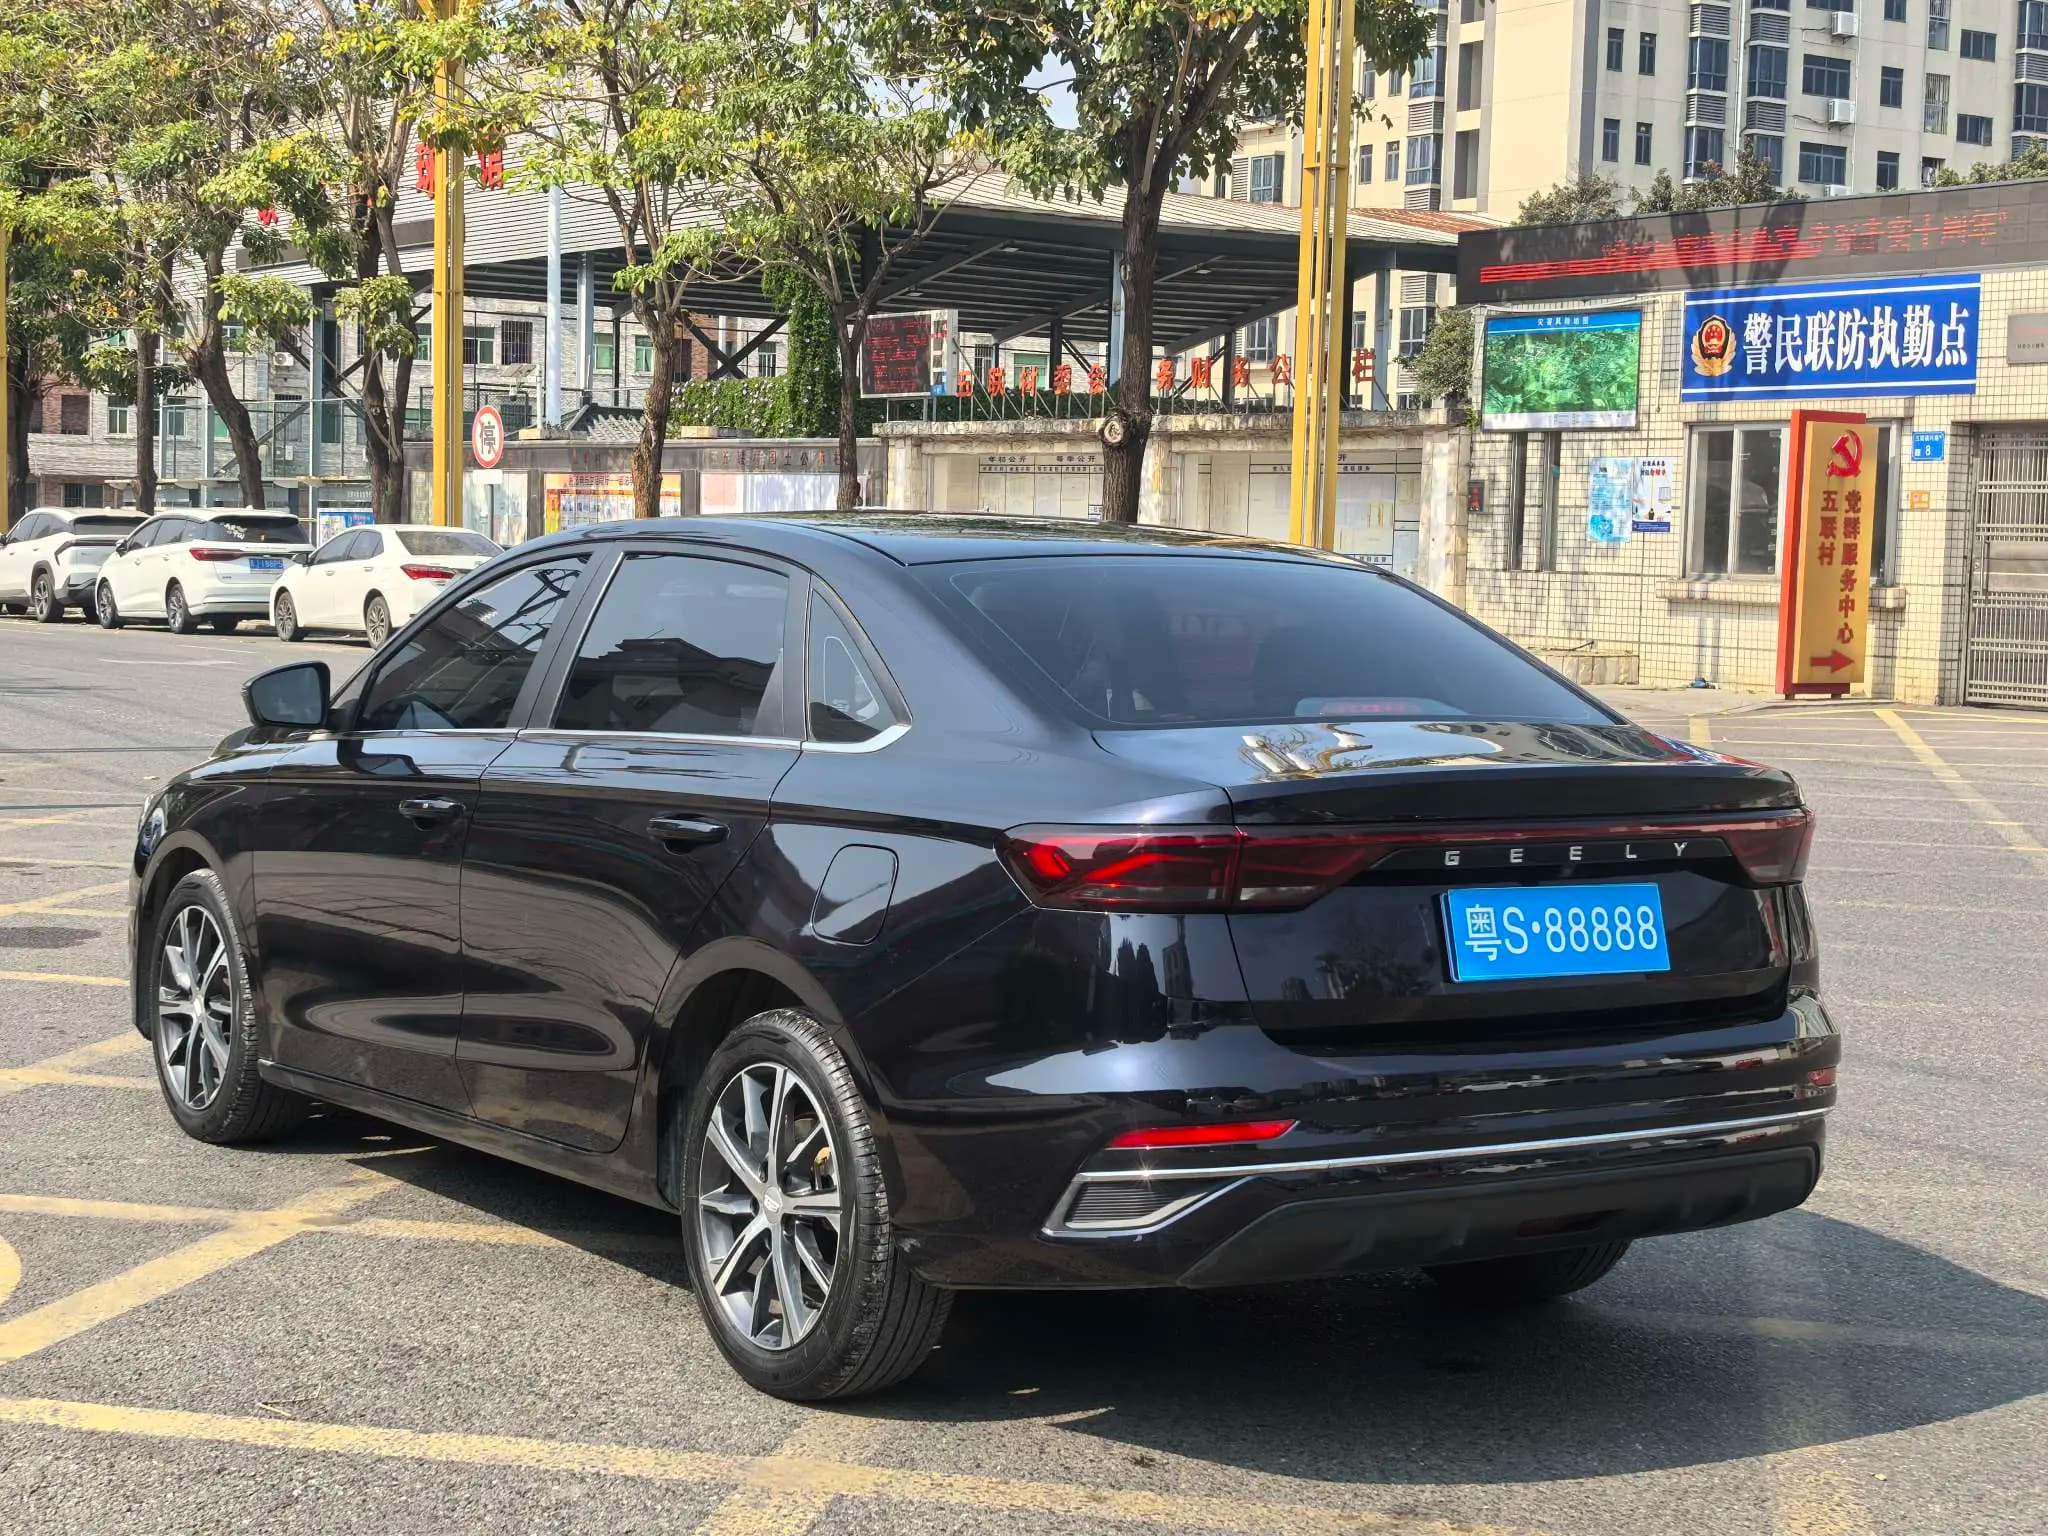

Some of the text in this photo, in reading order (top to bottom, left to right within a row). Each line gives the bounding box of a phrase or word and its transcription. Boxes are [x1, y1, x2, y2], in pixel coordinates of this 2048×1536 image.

[1743, 302, 1969, 375] 警民联防执勤点
[956, 347, 1378, 398] 五联村委会务财务公栏
[480, 421, 497, 454] 停
[1818, 490, 1839, 566] 五联村
[1837, 489, 1862, 644] 党群服务中心
[1444, 842, 1688, 866] GEELY
